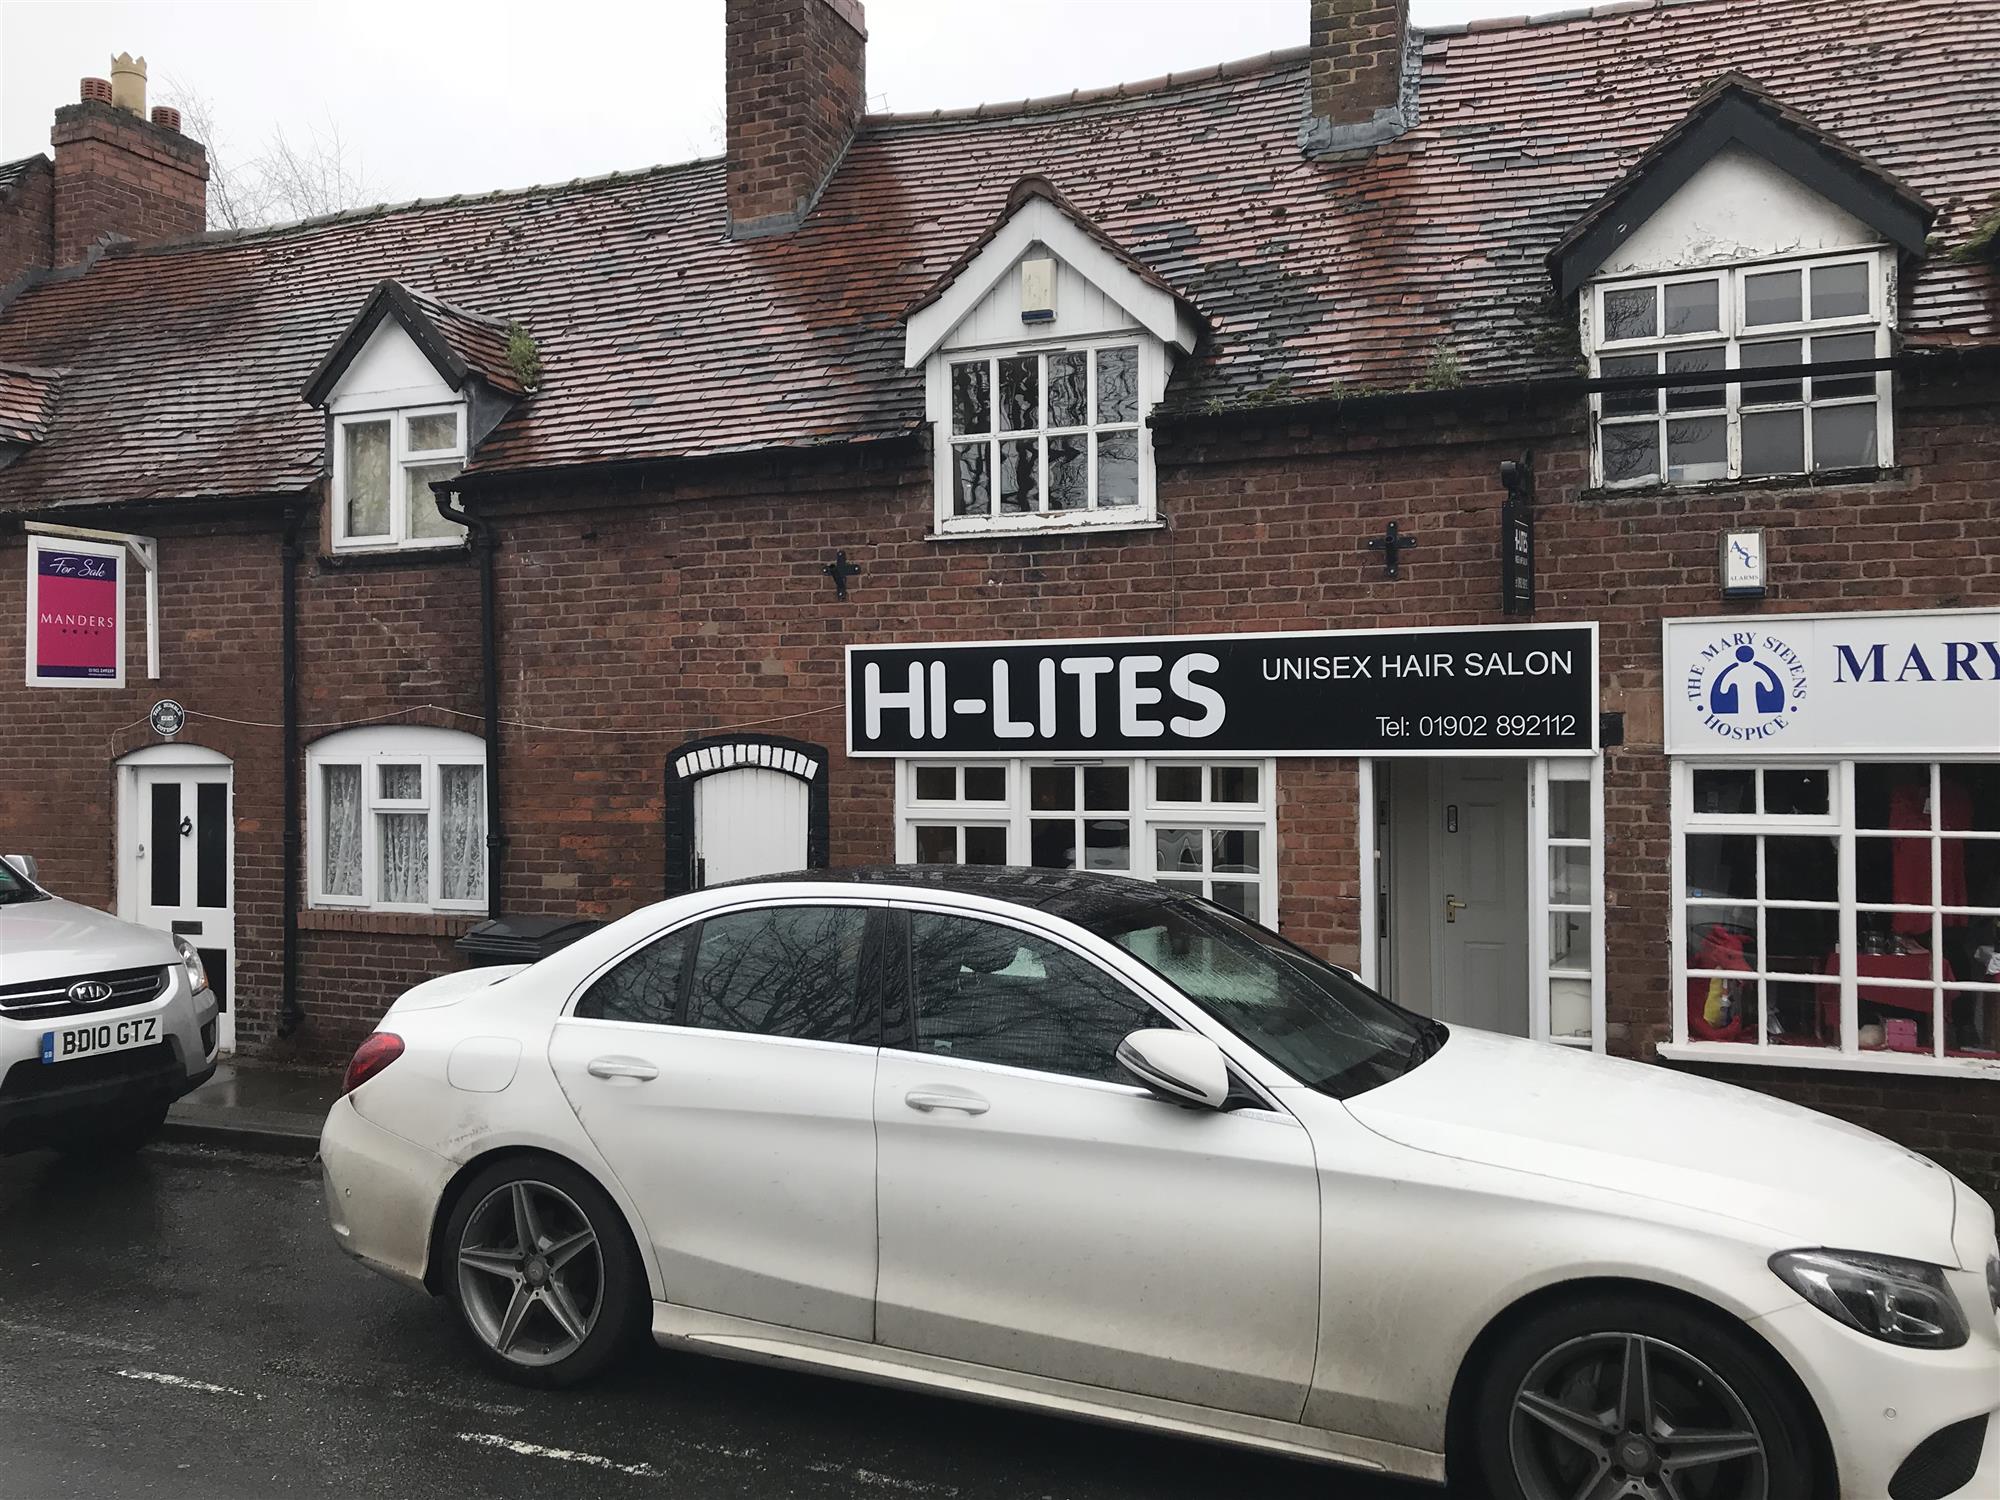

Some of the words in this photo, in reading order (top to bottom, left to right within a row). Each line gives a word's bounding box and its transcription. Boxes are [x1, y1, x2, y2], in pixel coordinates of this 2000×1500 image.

[50, 557, 78, 574] For
[78, 559, 105, 577] Sale
[41, 613, 113, 628] MANDERS
[1263, 656, 1372, 680] UNISEX
[1382, 654, 1454, 678] HAIR
[1464, 651, 1572, 676] SALON
[1688, 664, 1705, 701] THE
[1701, 632, 1756, 662] MARY
[1763, 636, 1807, 699] STEVENS
[865, 653, 1226, 740] HI-LITES
[1376, 716, 1410, 737] Tel:
[1419, 715, 1488, 737] 01902
[1496, 714, 1576, 737] 892112
[1704, 714, 1789, 740] HOSPICE
[76, 985, 106, 999] KIA
[63, 1025, 111, 1055] BD10
[117, 1017, 156, 1045] GTZ
